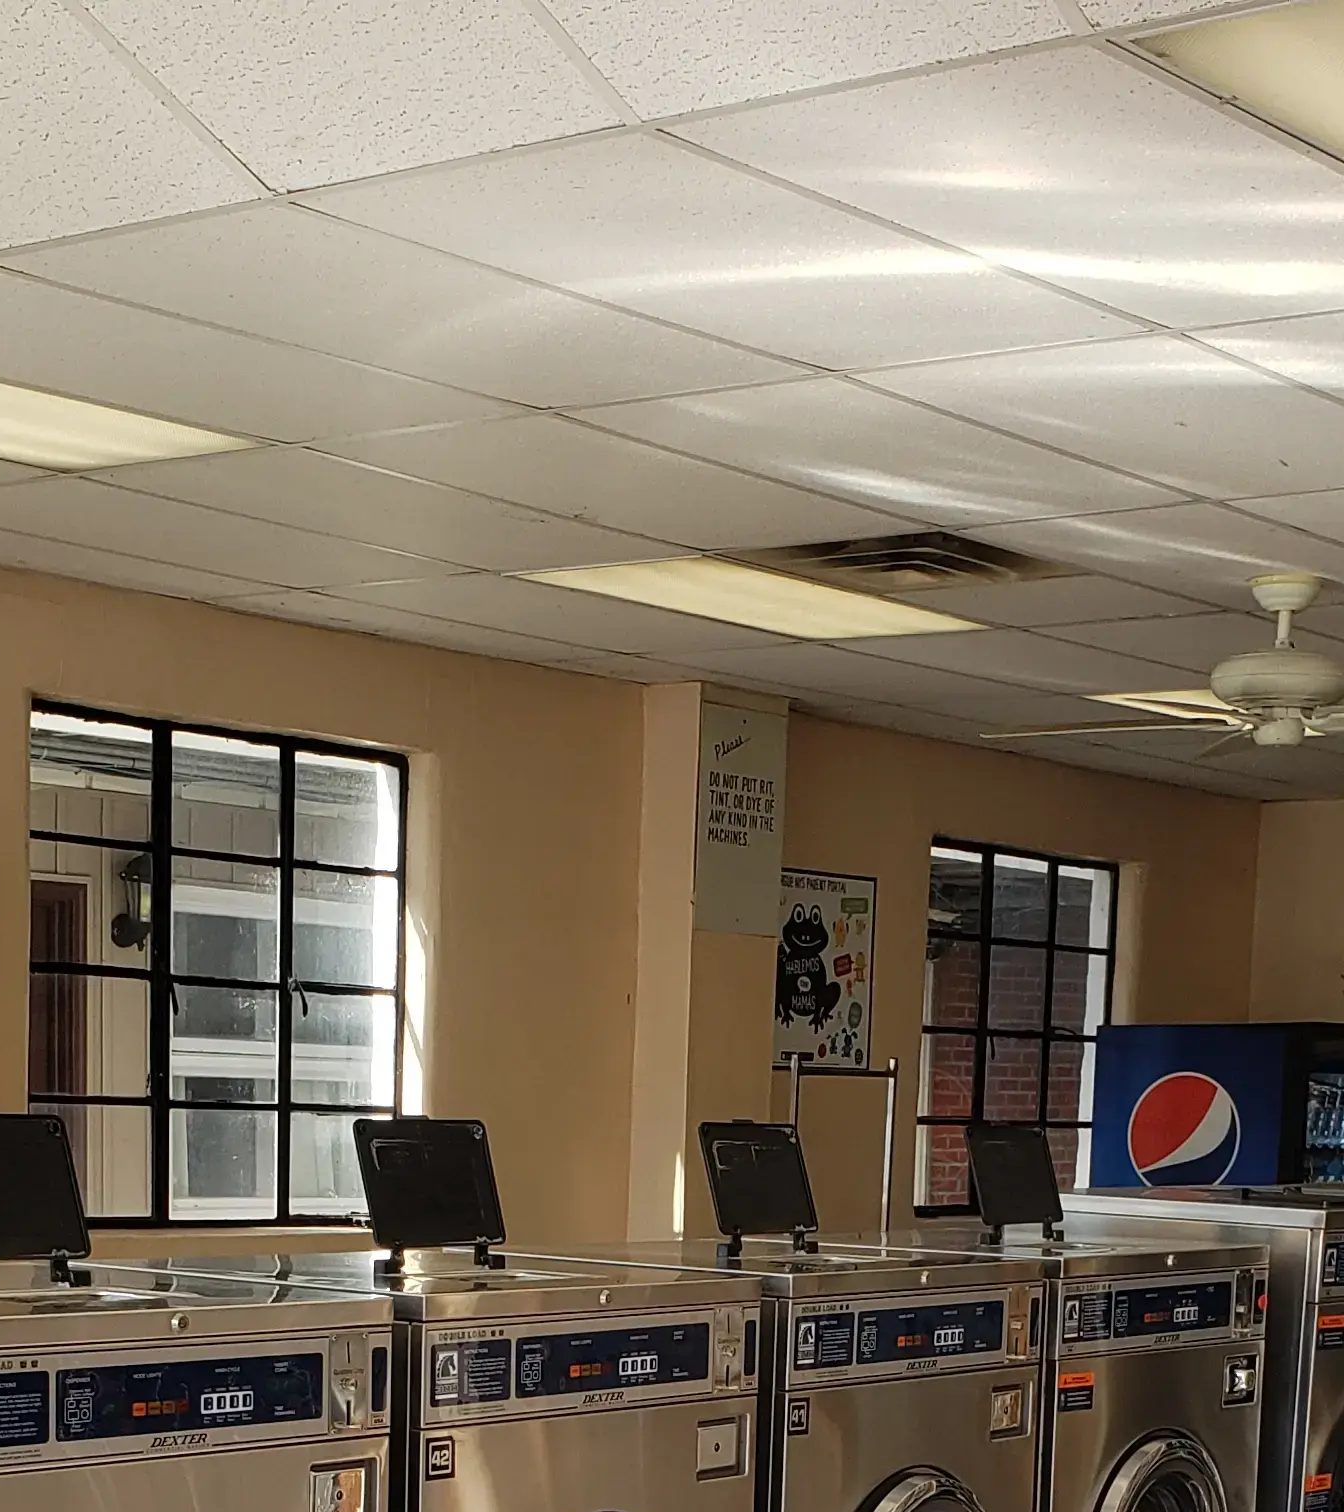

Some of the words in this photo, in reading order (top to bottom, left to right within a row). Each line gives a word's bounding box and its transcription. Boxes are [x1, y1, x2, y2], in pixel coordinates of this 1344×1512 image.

[709, 771, 720, 787] DO
[723, 773, 739, 789] NOT
[741, 775, 757, 792] PUT
[733, 794, 744, 810] OR
[746, 796, 761, 812] DYE
[765, 799, 774, 814] OF
[709, 809, 726, 825] ANY
[729, 812, 747, 828] KIND
[749, 814, 757, 829] IN
[760, 816, 774, 832] THE
[708, 827, 750, 847] MACHINES.
[582, 1391, 625, 1405] DEXTER
[792, 1407, 806, 1423] 41
[150, 1433, 208, 1448] DEXTER
[431, 1450, 450, 1467] 42
